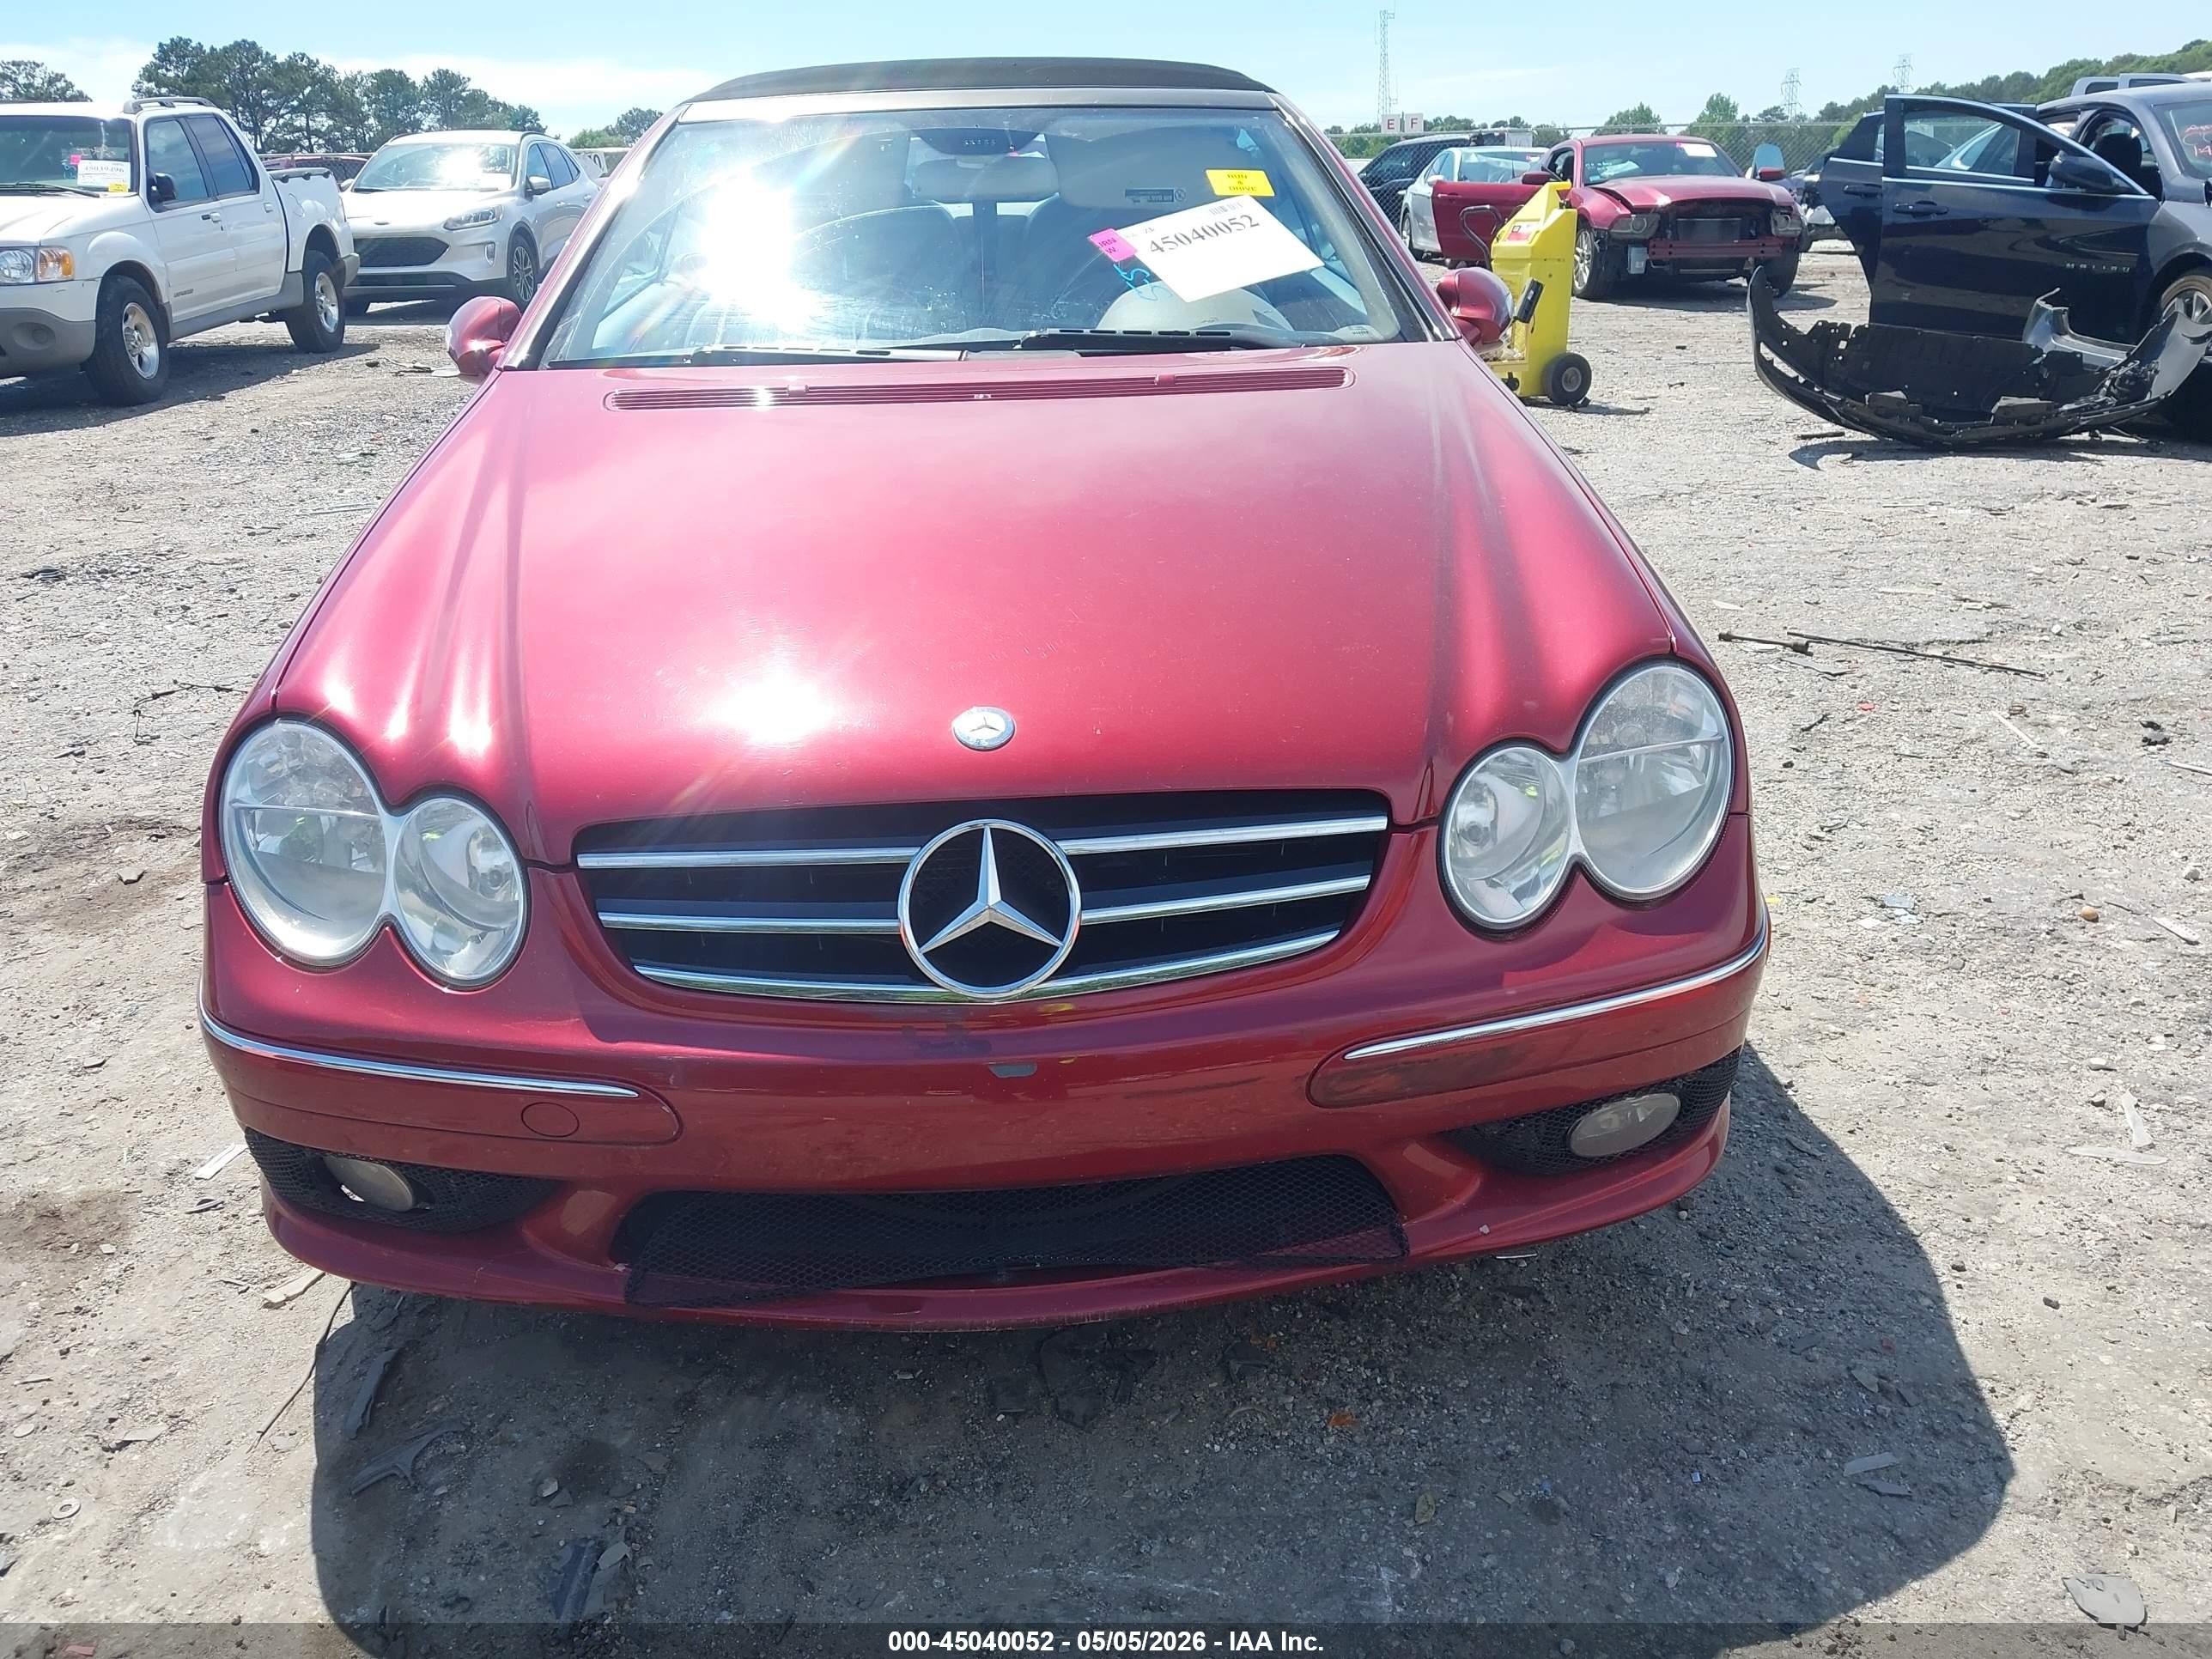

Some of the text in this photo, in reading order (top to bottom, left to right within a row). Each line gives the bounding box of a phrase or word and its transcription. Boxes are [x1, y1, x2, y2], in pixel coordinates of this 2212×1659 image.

[1388, 118, 1395, 130] E
[1411, 118, 1418, 129] F
[1150, 215, 1260, 253] 45040052
